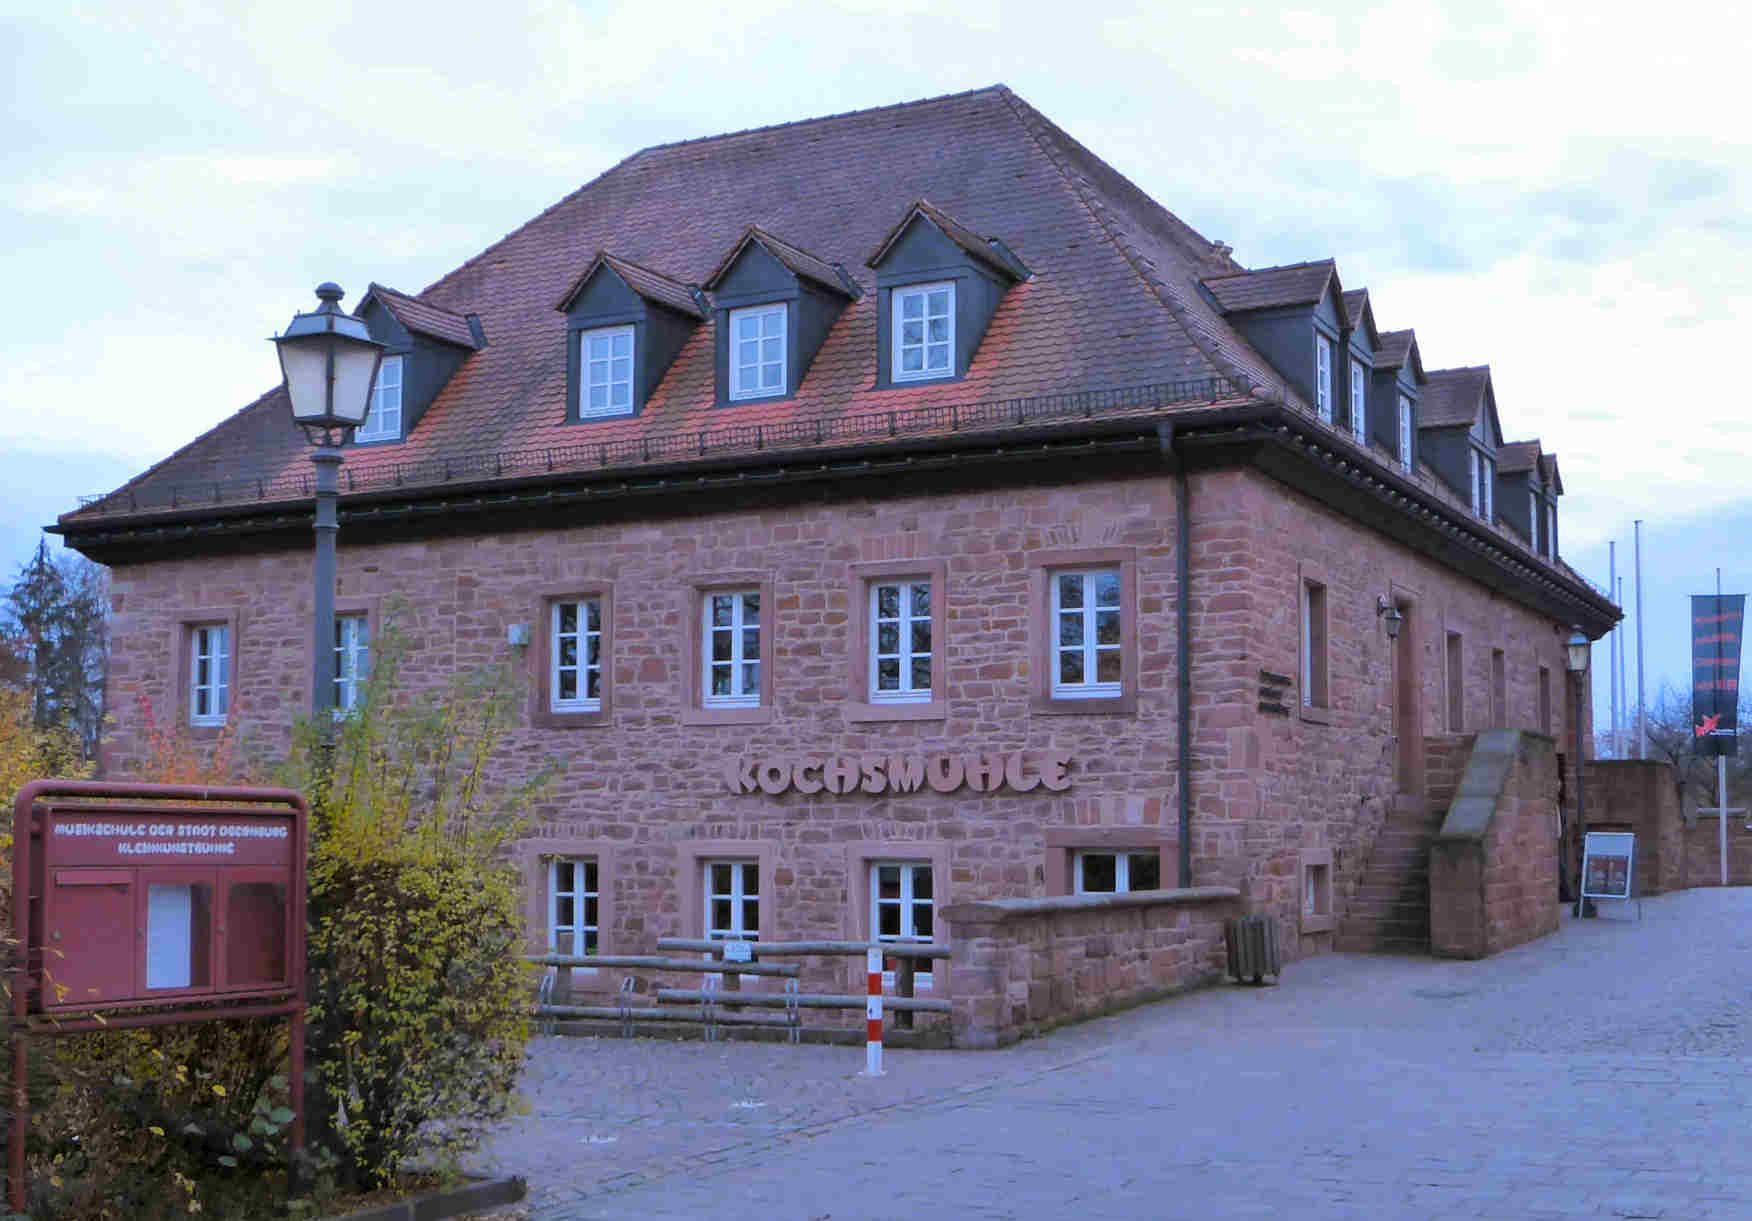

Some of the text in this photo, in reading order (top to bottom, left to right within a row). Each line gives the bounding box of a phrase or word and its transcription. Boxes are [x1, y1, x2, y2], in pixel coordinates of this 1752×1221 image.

[54, 823, 146, 836] MUSIKSCHULE
[149, 824, 174, 836] DER
[178, 825, 216, 837] STADT
